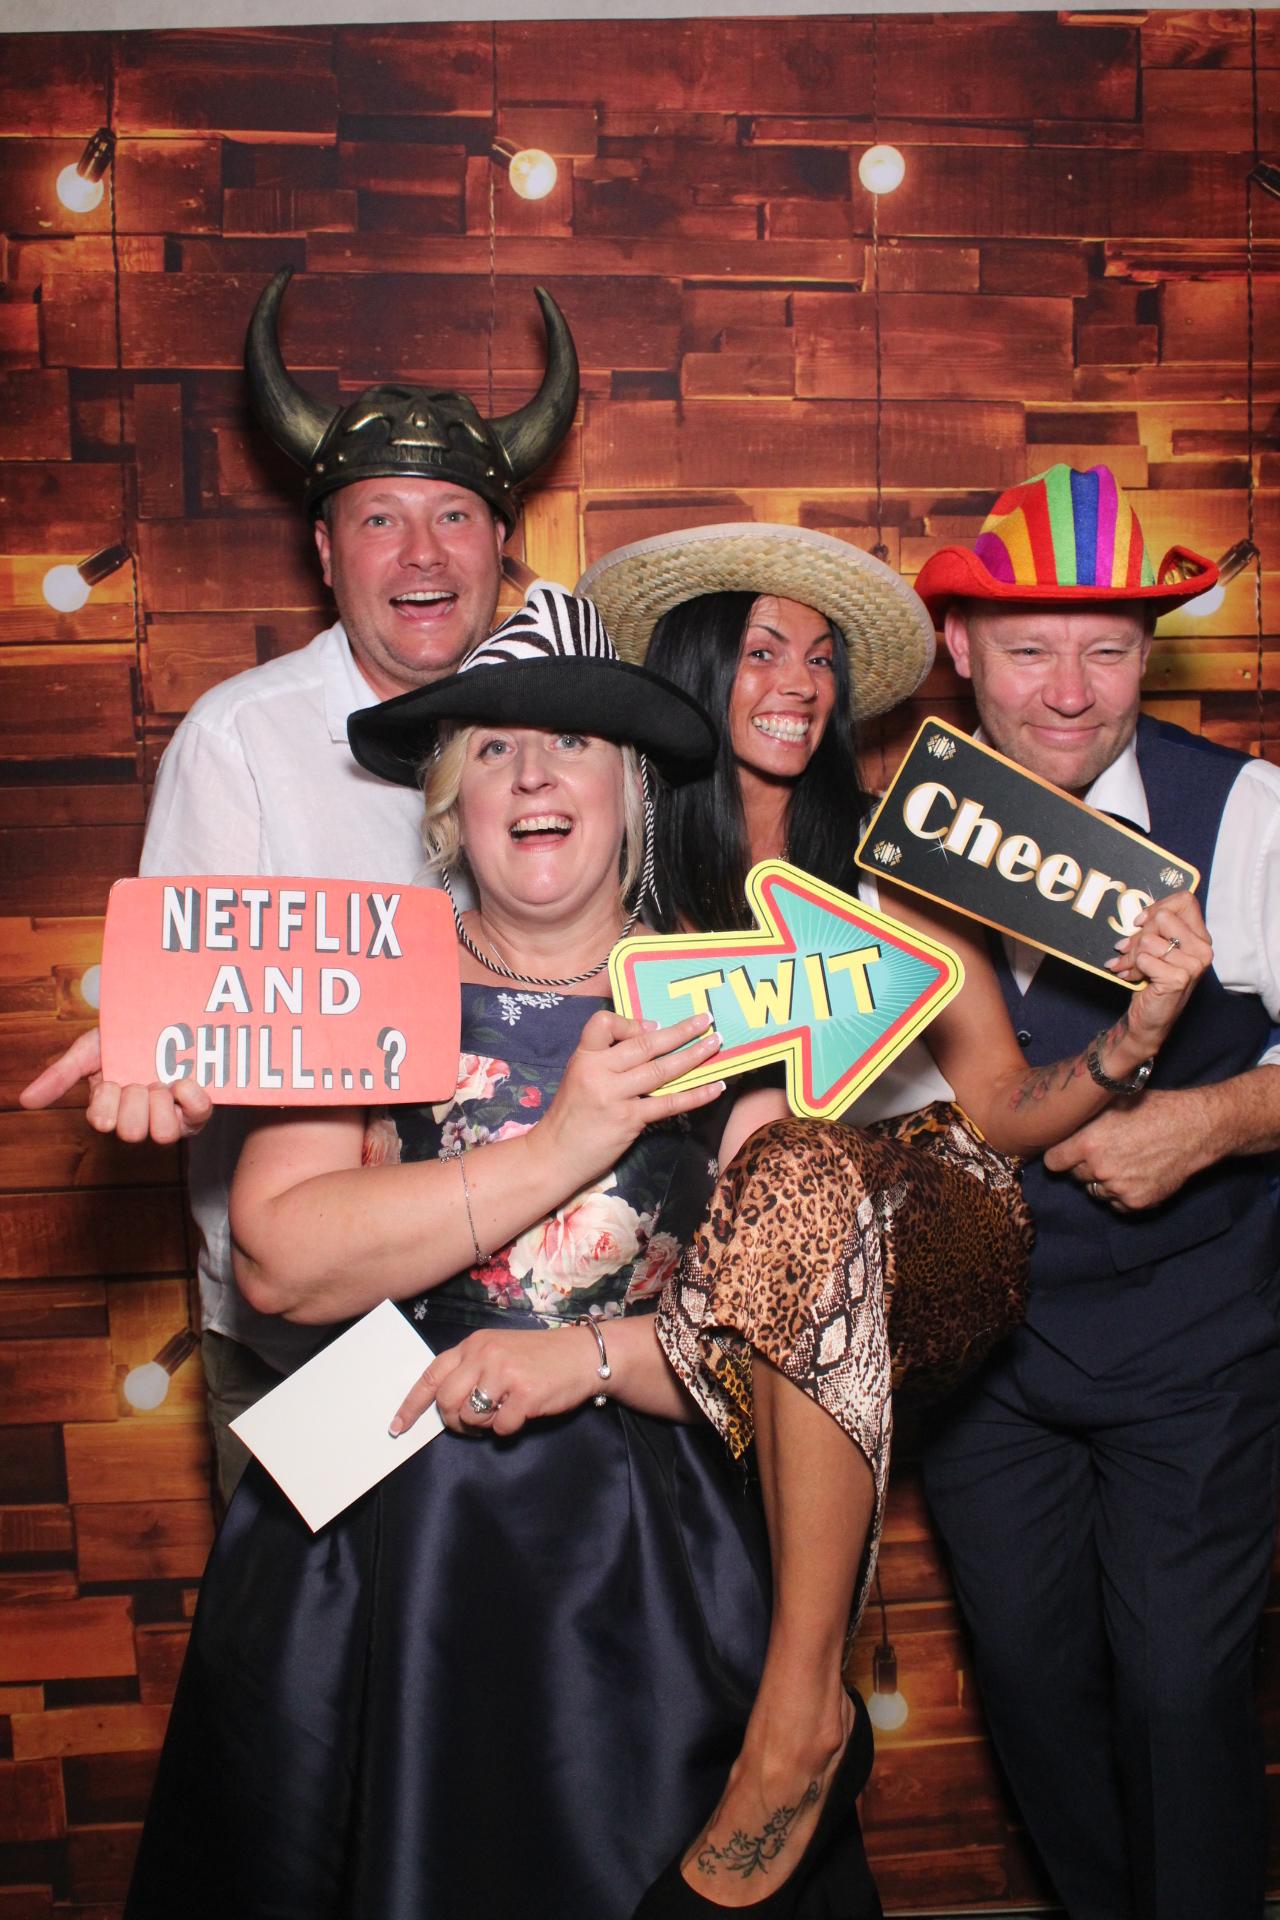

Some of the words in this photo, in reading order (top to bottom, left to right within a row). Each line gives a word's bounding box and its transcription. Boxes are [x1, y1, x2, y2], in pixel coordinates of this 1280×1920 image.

[903, 782, 1155, 937] Cheers
[162, 886, 402, 957] NETFLIX
[204, 965, 361, 1015] AND
[667, 944, 881, 1034] TWIT
[155, 1023, 407, 1090] CHILL...?
